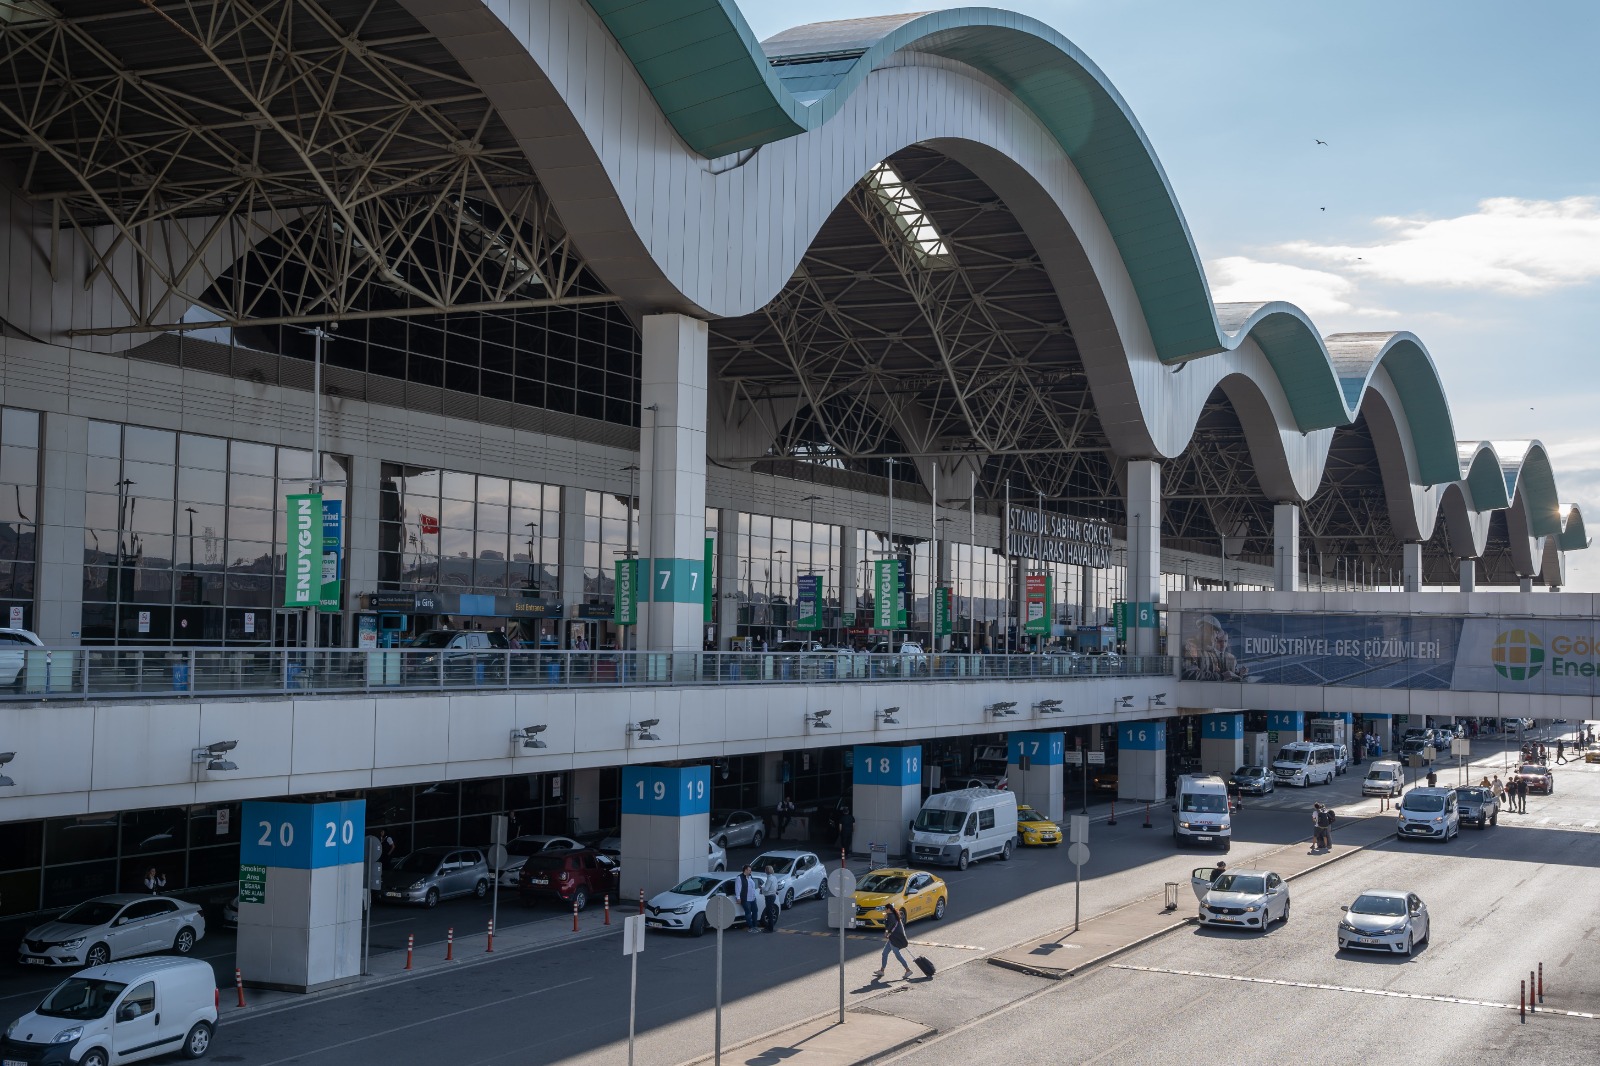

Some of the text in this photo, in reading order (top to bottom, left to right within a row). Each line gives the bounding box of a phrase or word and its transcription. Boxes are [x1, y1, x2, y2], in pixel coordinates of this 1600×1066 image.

[296, 499, 312, 602] ENUYGUN
[659, 570, 671, 590] 7
[690, 572, 698, 592] 7
[621, 562, 630, 623] ENUYGUN
[881, 563, 891, 627] ENUYGUN
[515, 602, 545, 612] East Entrance
[1140, 609, 1148, 621] 6
[1244, 634, 1440, 661] ENDÜSTRİYEL GES ÇÖZÜMLERİ
[1209, 721, 1228, 732] 15
[1274, 715, 1290, 725] 14
[1127, 729, 1147, 742] 16
[1017, 741, 1040, 755] 17
[1052, 741, 1061, 755] 17
[864, 757, 890, 774] 18
[906, 757, 918, 774] 18
[635, 780, 666, 801] 19
[687, 780, 704, 801] 19
[257, 820, 294, 847] 20
[324, 819, 354, 848] 20
[240, 865, 266, 875] Smoking
[246, 873, 260, 881] Area
